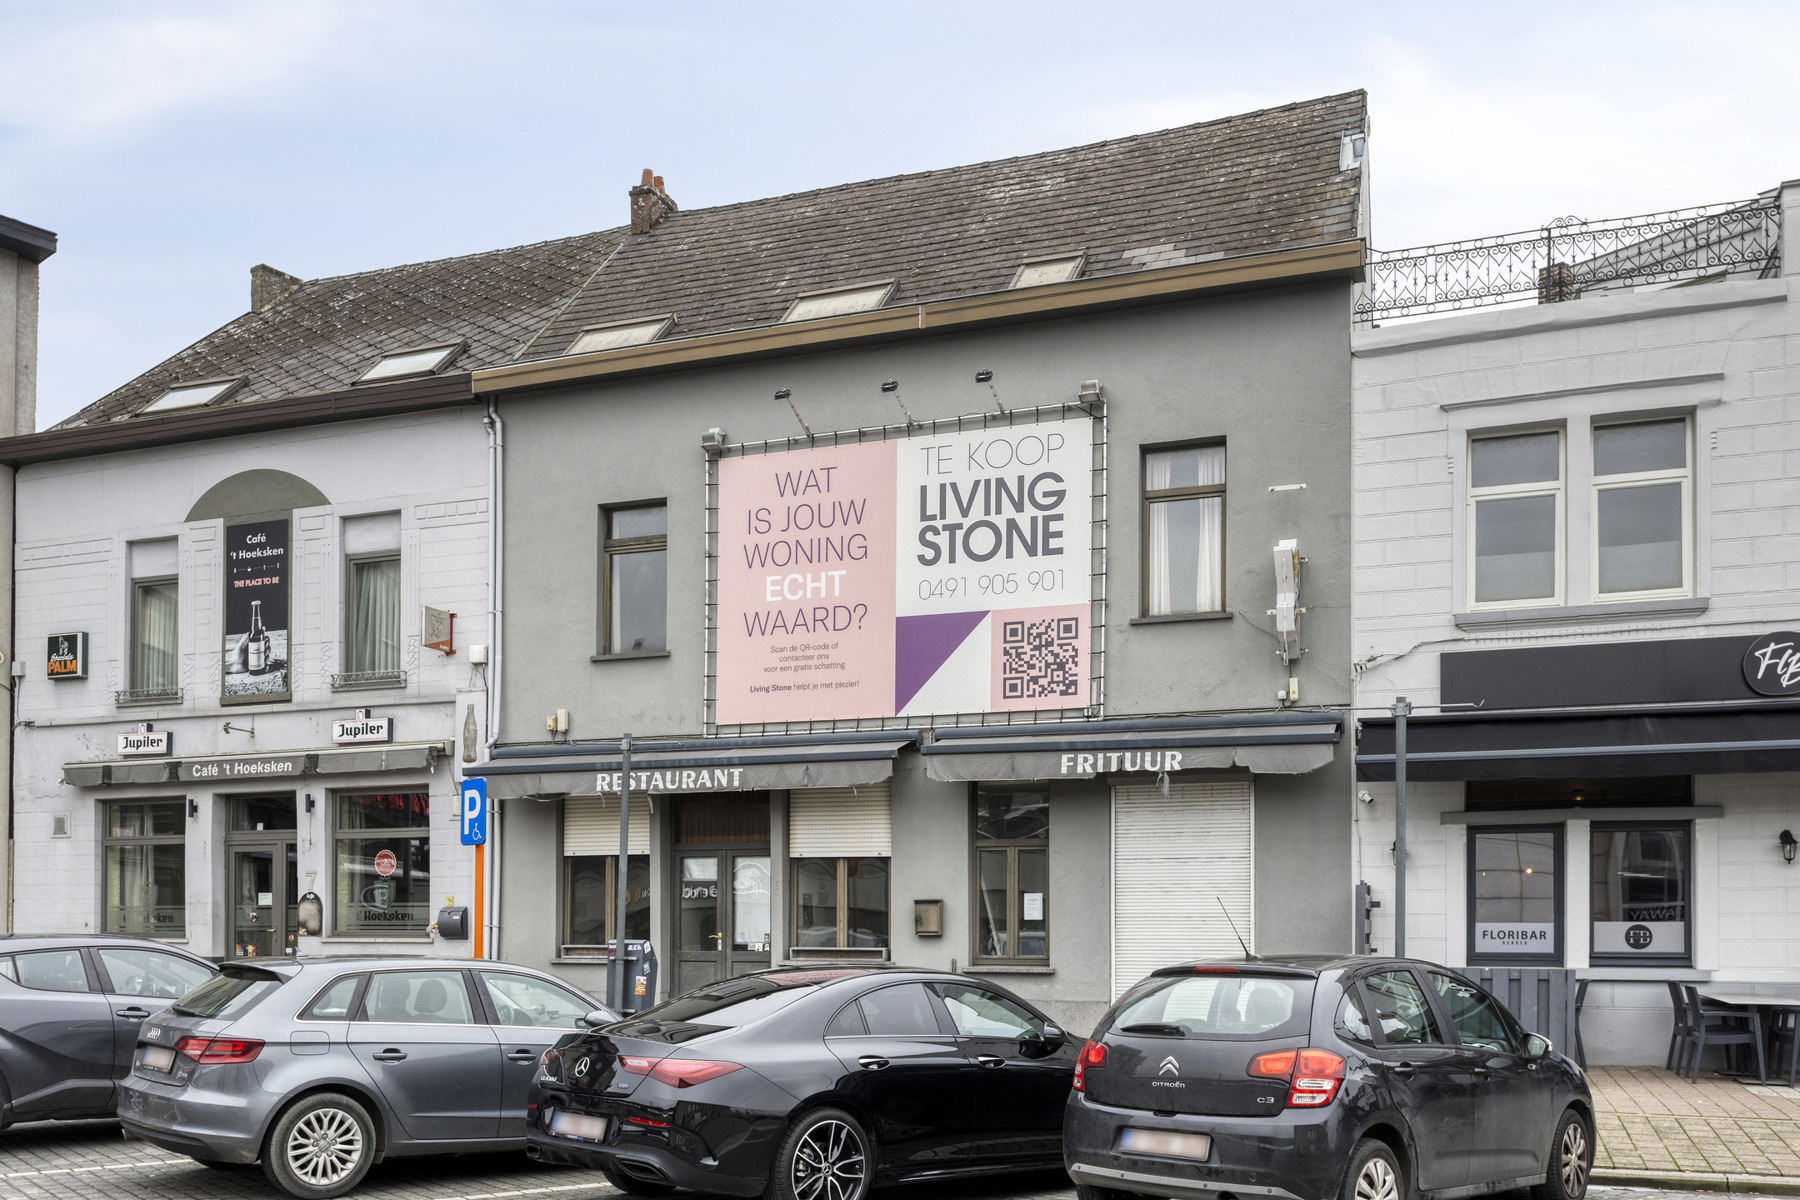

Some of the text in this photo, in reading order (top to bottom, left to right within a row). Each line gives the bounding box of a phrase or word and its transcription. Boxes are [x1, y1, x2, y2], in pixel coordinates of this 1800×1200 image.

[920, 433, 1064, 476] TE KOOP
[775, 466, 838, 498] WAT
[920, 472, 1066, 522] LIVING
[748, 498, 866, 535] IS JOUW
[246, 533, 266, 544] Café
[917, 513, 1064, 566] STONE
[239, 546, 284, 559] Hoeksken
[744, 534, 868, 568] WONING
[246, 578, 262, 586] PLACE
[766, 570, 846, 602] ECHT
[918, 569, 1064, 600] 0491 905 901
[744, 603, 868, 637] WAARD?
[789, 644, 798, 652] de
[800, 643, 830, 652] QR-code
[779, 654, 816, 662] contacteer
[48, 660, 77, 674] PALM
[794, 664, 812, 673] gratis
[814, 661, 846, 670] schatting
[750, 685, 770, 694] Living
[812, 682, 819, 690] je
[835, 680, 859, 690] plezier!
[338, 723, 384, 739] Jupiler
[122, 735, 163, 750] Jupiler
[192, 762, 218, 777] Café
[234, 761, 292, 775] Hoeksken
[1060, 751, 1182, 774] FRITUUR
[596, 768, 743, 792] RESTAURANT
[464, 789, 481, 834] P
[364, 910, 414, 921] Hoeksken
[1482, 930, 1547, 940] FLORIBAR
